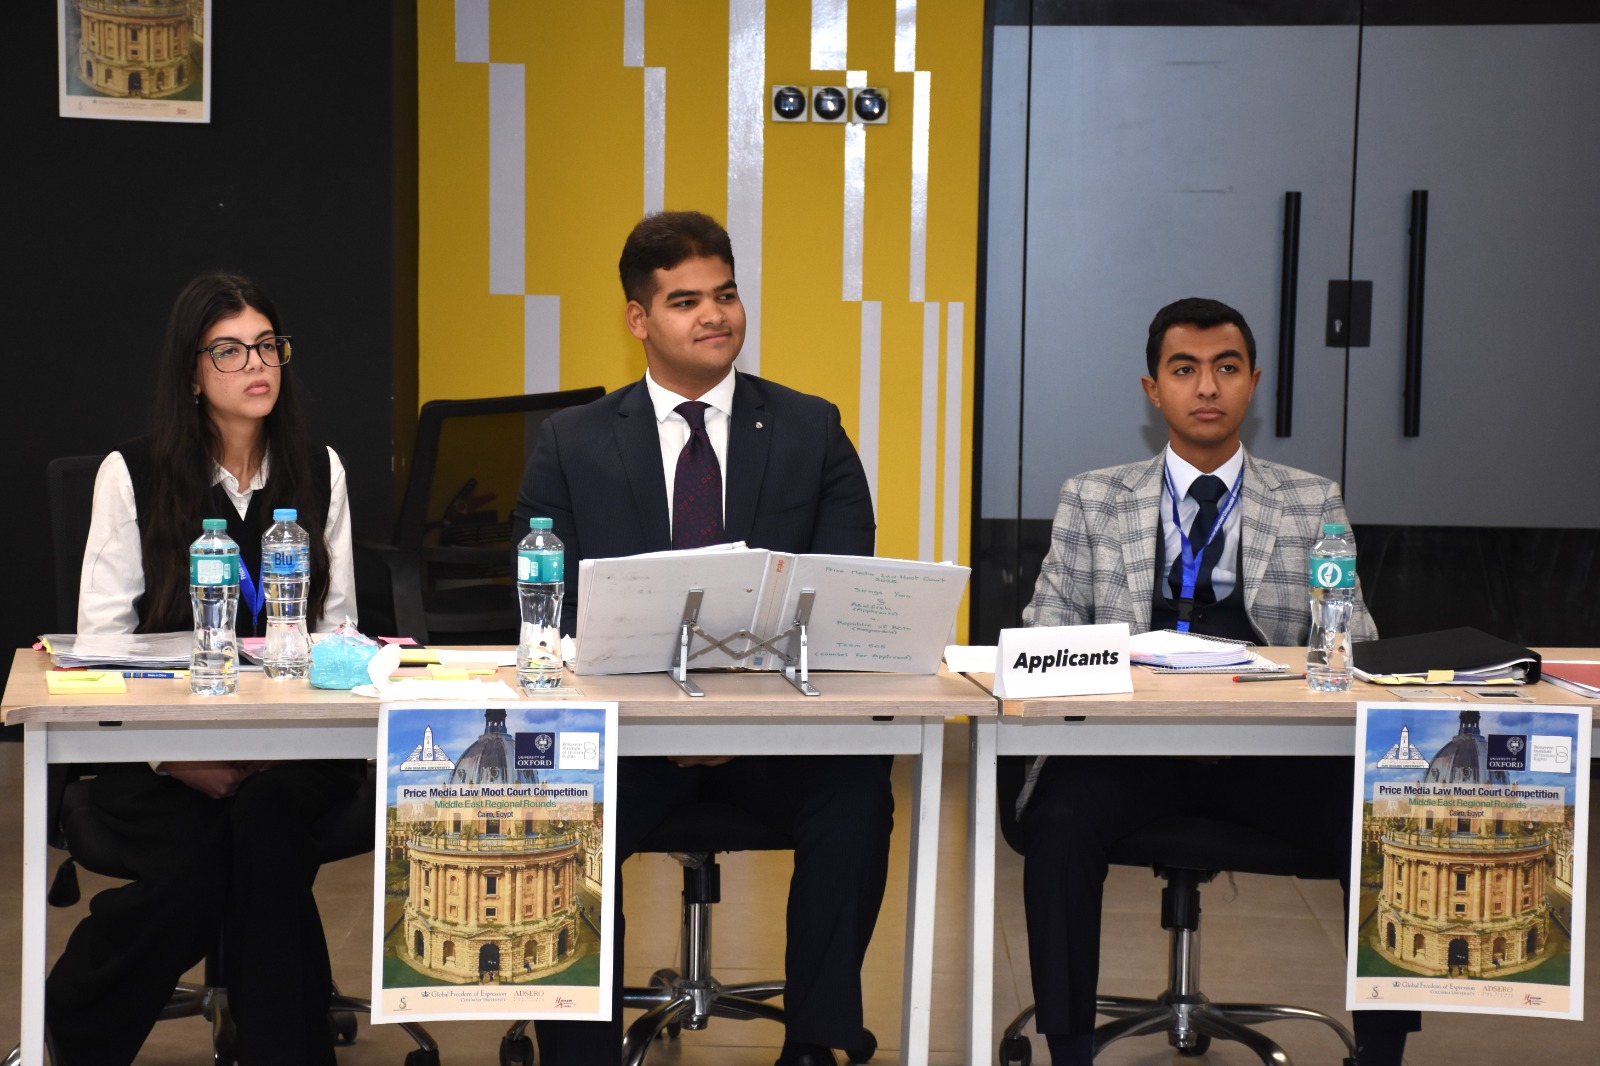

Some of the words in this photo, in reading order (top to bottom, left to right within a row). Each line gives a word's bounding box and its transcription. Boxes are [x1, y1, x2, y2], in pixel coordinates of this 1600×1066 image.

[274, 552, 293, 566] Blu
[1013, 649, 1119, 673] Applicants
[403, 789, 427, 798] Price
[429, 788, 458, 798] Media
[460, 788, 479, 798] Law
[481, 788, 506, 798] Moot
[507, 787, 531, 798] Court
[533, 787, 588, 799] Competition
[1379, 786, 1402, 795] Price
[1403, 786, 1431, 796] Media
[1433, 786, 1451, 796] Law
[1453, 787, 1477, 797] Moot
[1478, 787, 1503, 797] Court
[1504, 788, 1559, 800] Competition
[434, 800, 464, 809] Middle
[464, 800, 485, 809] East
[485, 800, 523, 810] Regional
[524, 800, 557, 809] Rounds
[1408, 798, 1438, 807] Middle
[1438, 798, 1456, 807] East
[1456, 799, 1494, 809] Regional
[1494, 800, 1527, 809] Rounds
[477, 811, 495, 819] Cairo,
[496, 811, 514, 819] Egypt
[1449, 810, 1467, 818] Cairo,
[1467, 810, 1484, 819] Egypt
